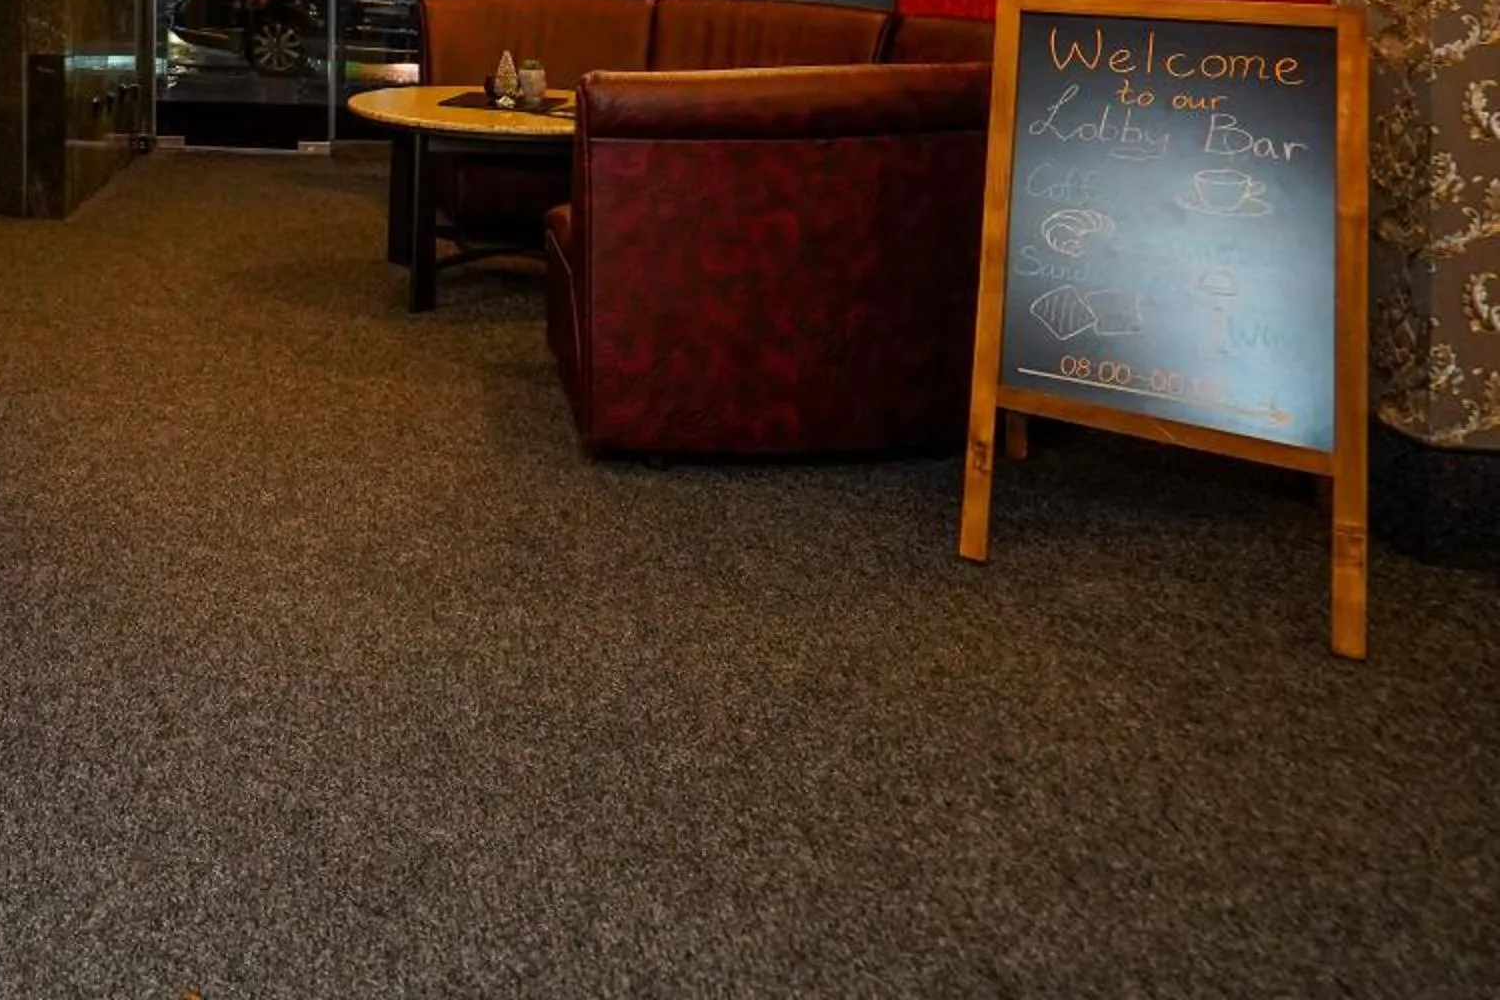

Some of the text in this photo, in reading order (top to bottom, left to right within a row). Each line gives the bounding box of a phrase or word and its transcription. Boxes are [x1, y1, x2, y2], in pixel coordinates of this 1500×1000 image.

[1050, 26, 1304, 86] Welcome
[1116, 79, 1229, 112] to our
[1029, 83, 1310, 161] Lobby Bar
[1026, 162, 1100, 206] Coff
